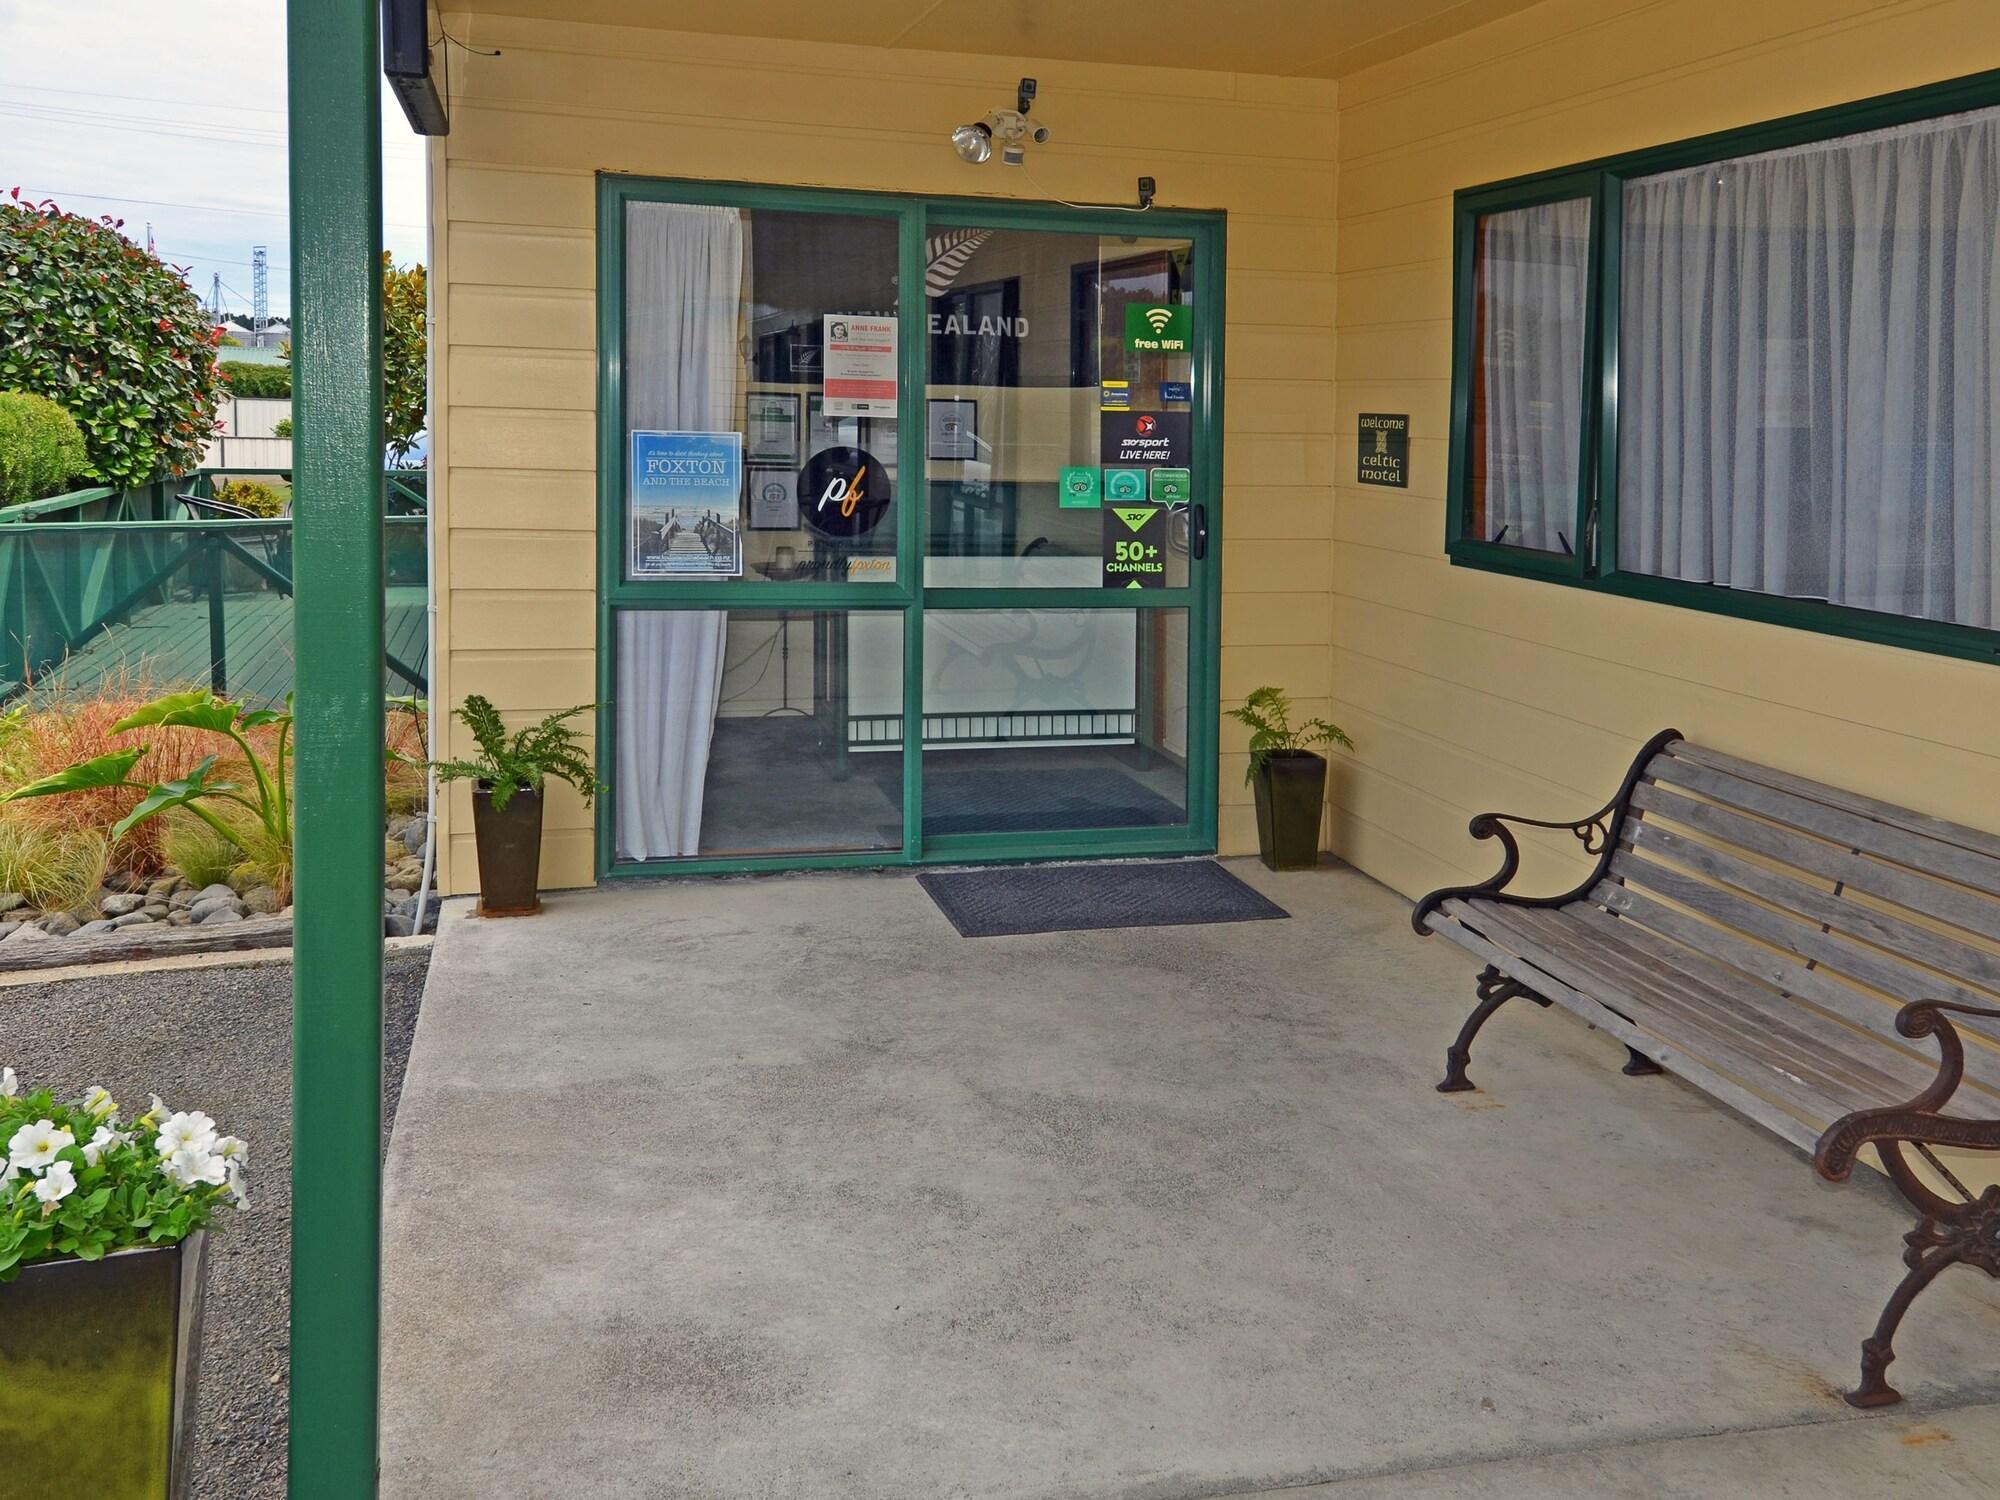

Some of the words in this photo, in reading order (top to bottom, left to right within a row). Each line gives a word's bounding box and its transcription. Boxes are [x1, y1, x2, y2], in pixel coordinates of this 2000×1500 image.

[851, 324, 868, 332] ANNE
[870, 325, 892, 333] FRANK
[927, 313, 1029, 338] EALAND
[1134, 338, 1159, 349] free
[1161, 340, 1184, 350] WiFi
[1361, 416, 1405, 430] welcome
[1120, 450, 1142, 460] LIVE
[1142, 450, 1171, 460] HERE!
[1362, 454, 1401, 468] celtic
[646, 459, 727, 474] FOXTON
[643, 477, 667, 486] AND
[668, 477, 691, 486] THE
[693, 478, 729, 487] BEACH
[1361, 469, 1401, 482] motel
[1115, 541, 1158, 561] 50+
[1106, 562, 1163, 573] CHANNELS
